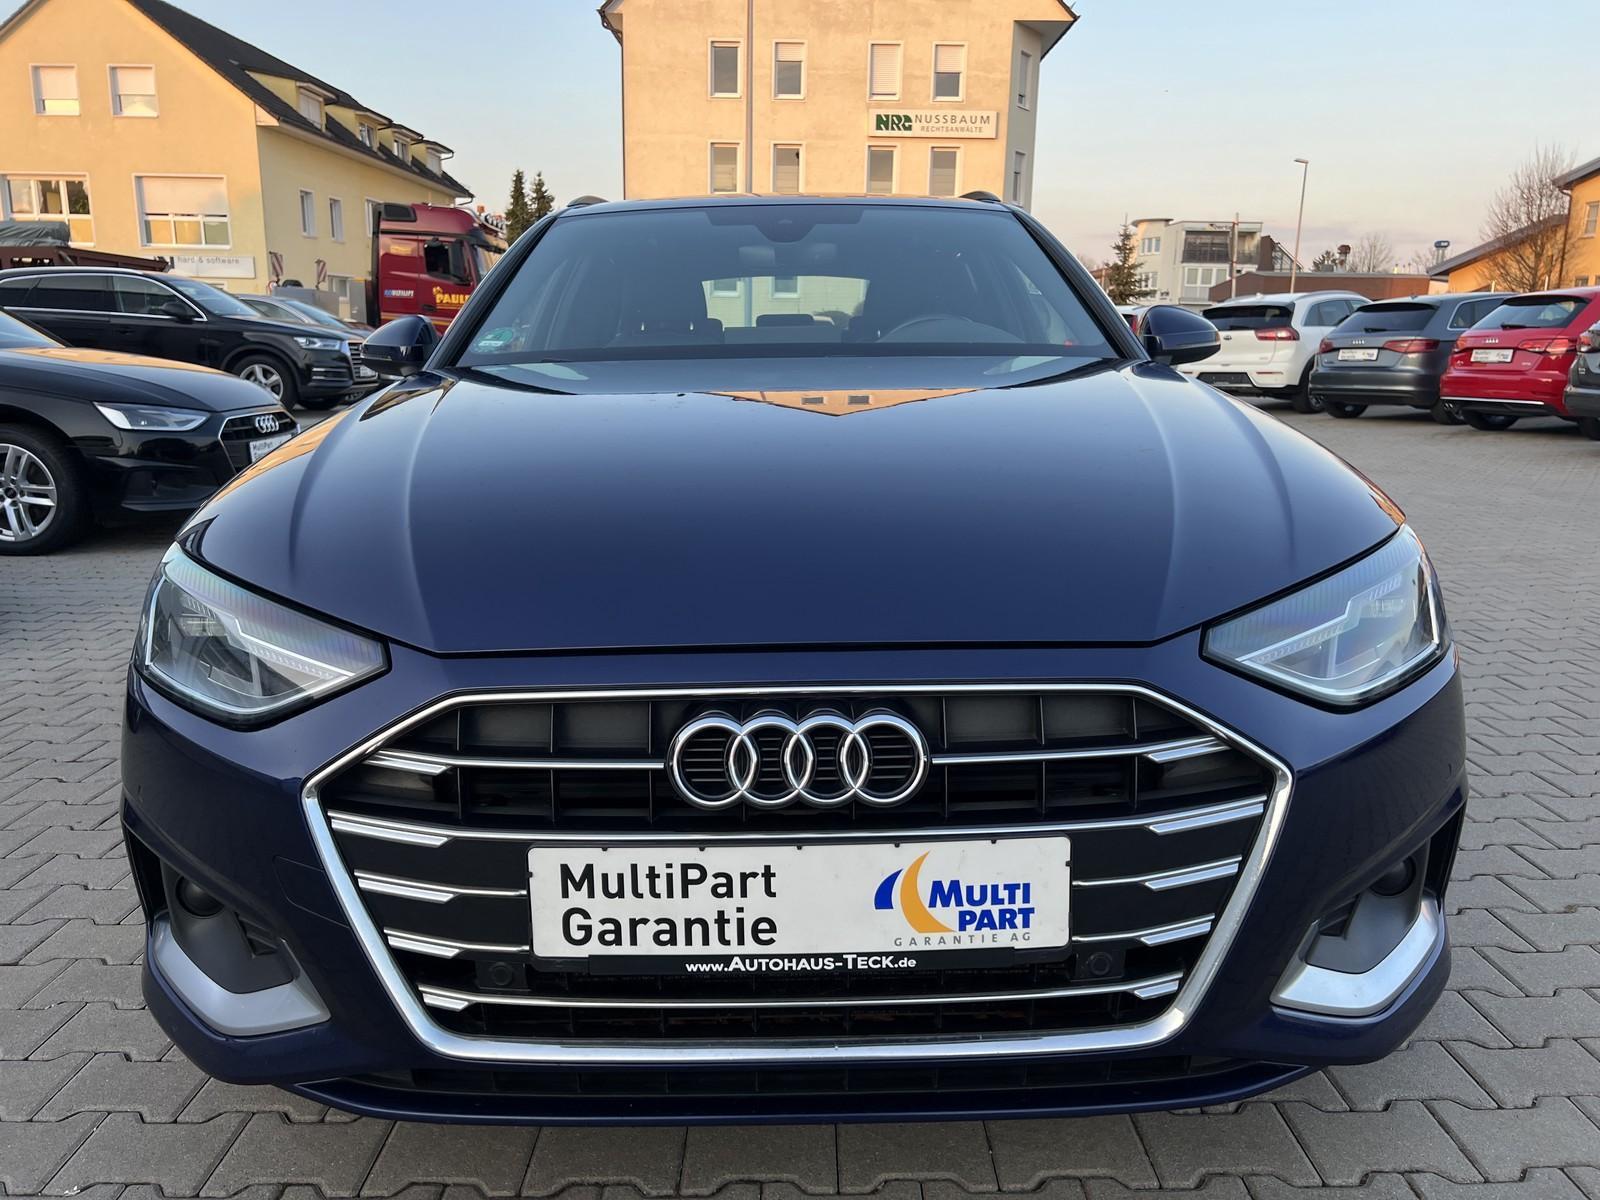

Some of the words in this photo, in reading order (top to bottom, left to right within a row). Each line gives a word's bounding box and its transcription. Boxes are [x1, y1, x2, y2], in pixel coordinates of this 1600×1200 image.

[915, 114, 990, 124] NUSSBAUM
[921, 125, 983, 133] RECHTSANWÄLTE
[177, 256, 195, 264] hard
[206, 256, 240, 264] software
[560, 863, 777, 899] MultiPart
[928, 880, 1031, 908] MULTI
[561, 907, 778, 946] Garantie
[958, 908, 1035, 932] PART
[894, 933, 998, 947] GARANTIE
[1010, 932, 1031, 942] AG
